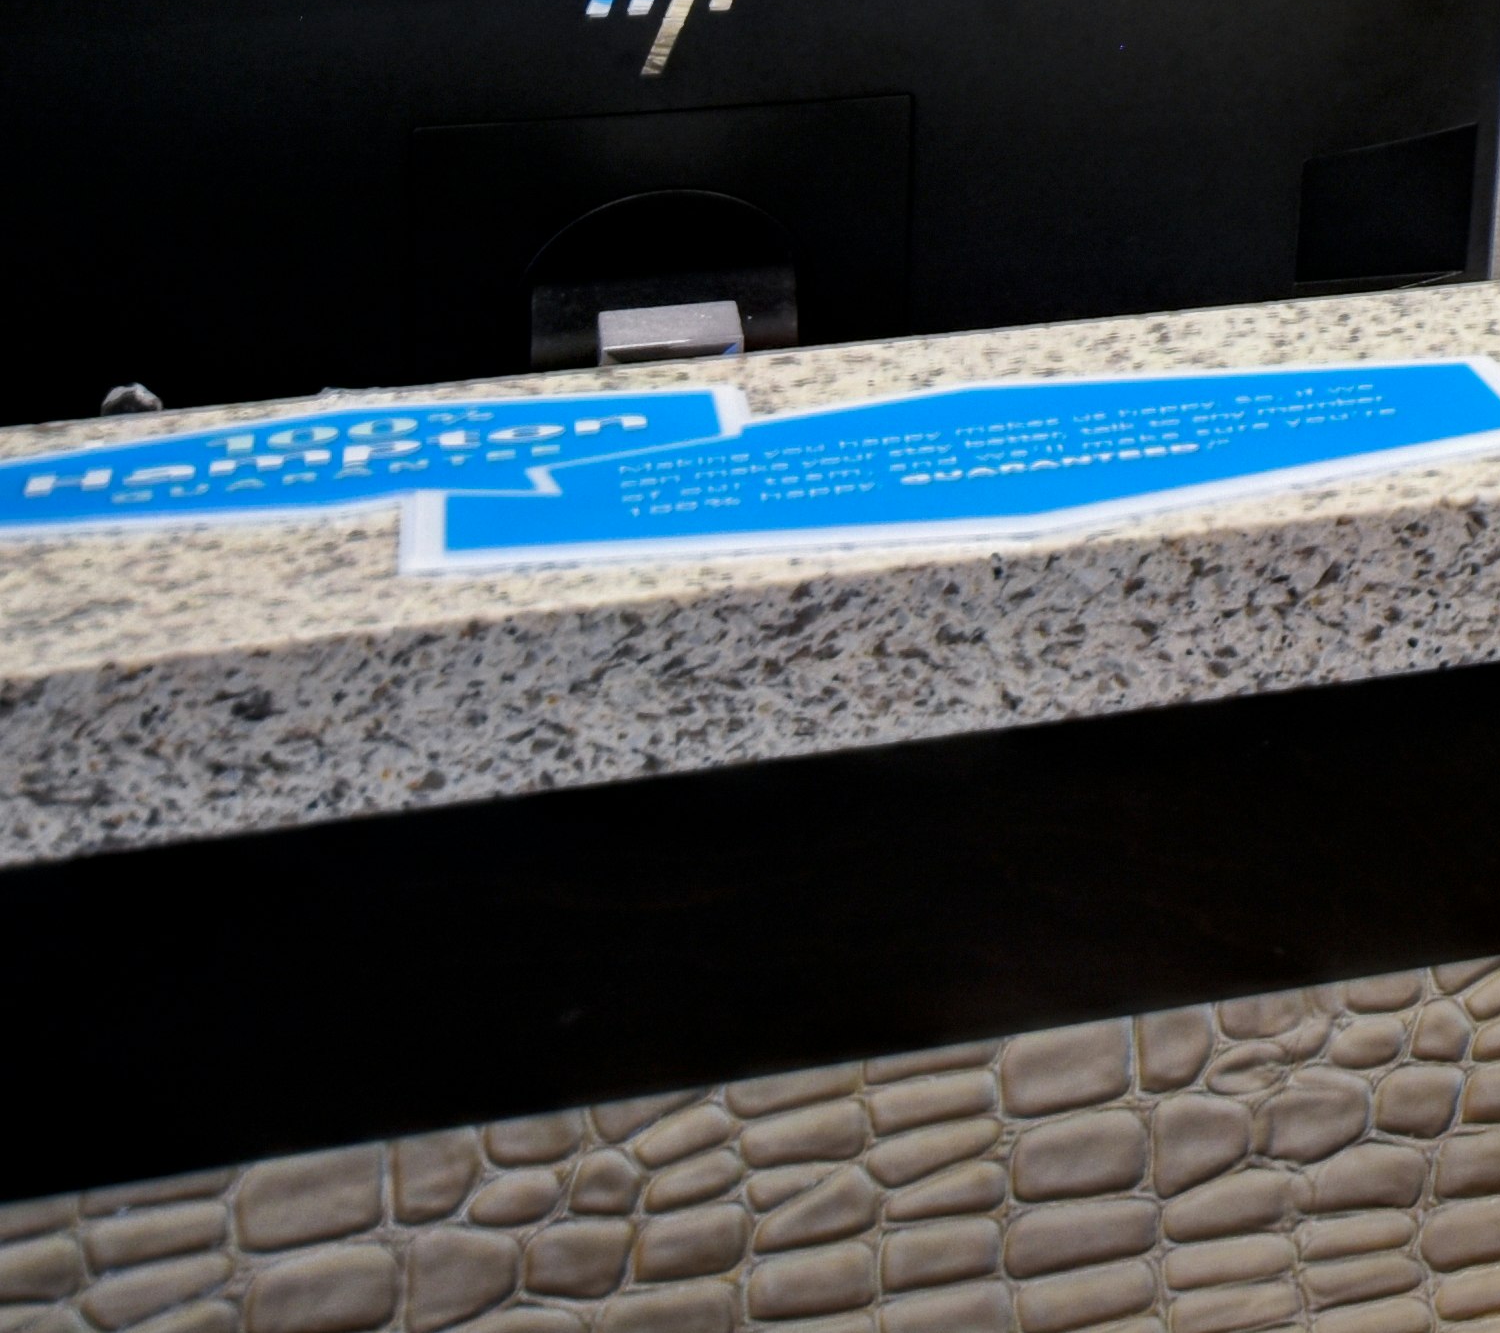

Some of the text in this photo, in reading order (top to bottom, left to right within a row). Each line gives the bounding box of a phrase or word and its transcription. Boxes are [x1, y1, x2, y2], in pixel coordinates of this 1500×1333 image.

[205, 406, 494, 455] 100%
[764, 443, 825, 459] you
[24, 413, 648, 500] Hampton
